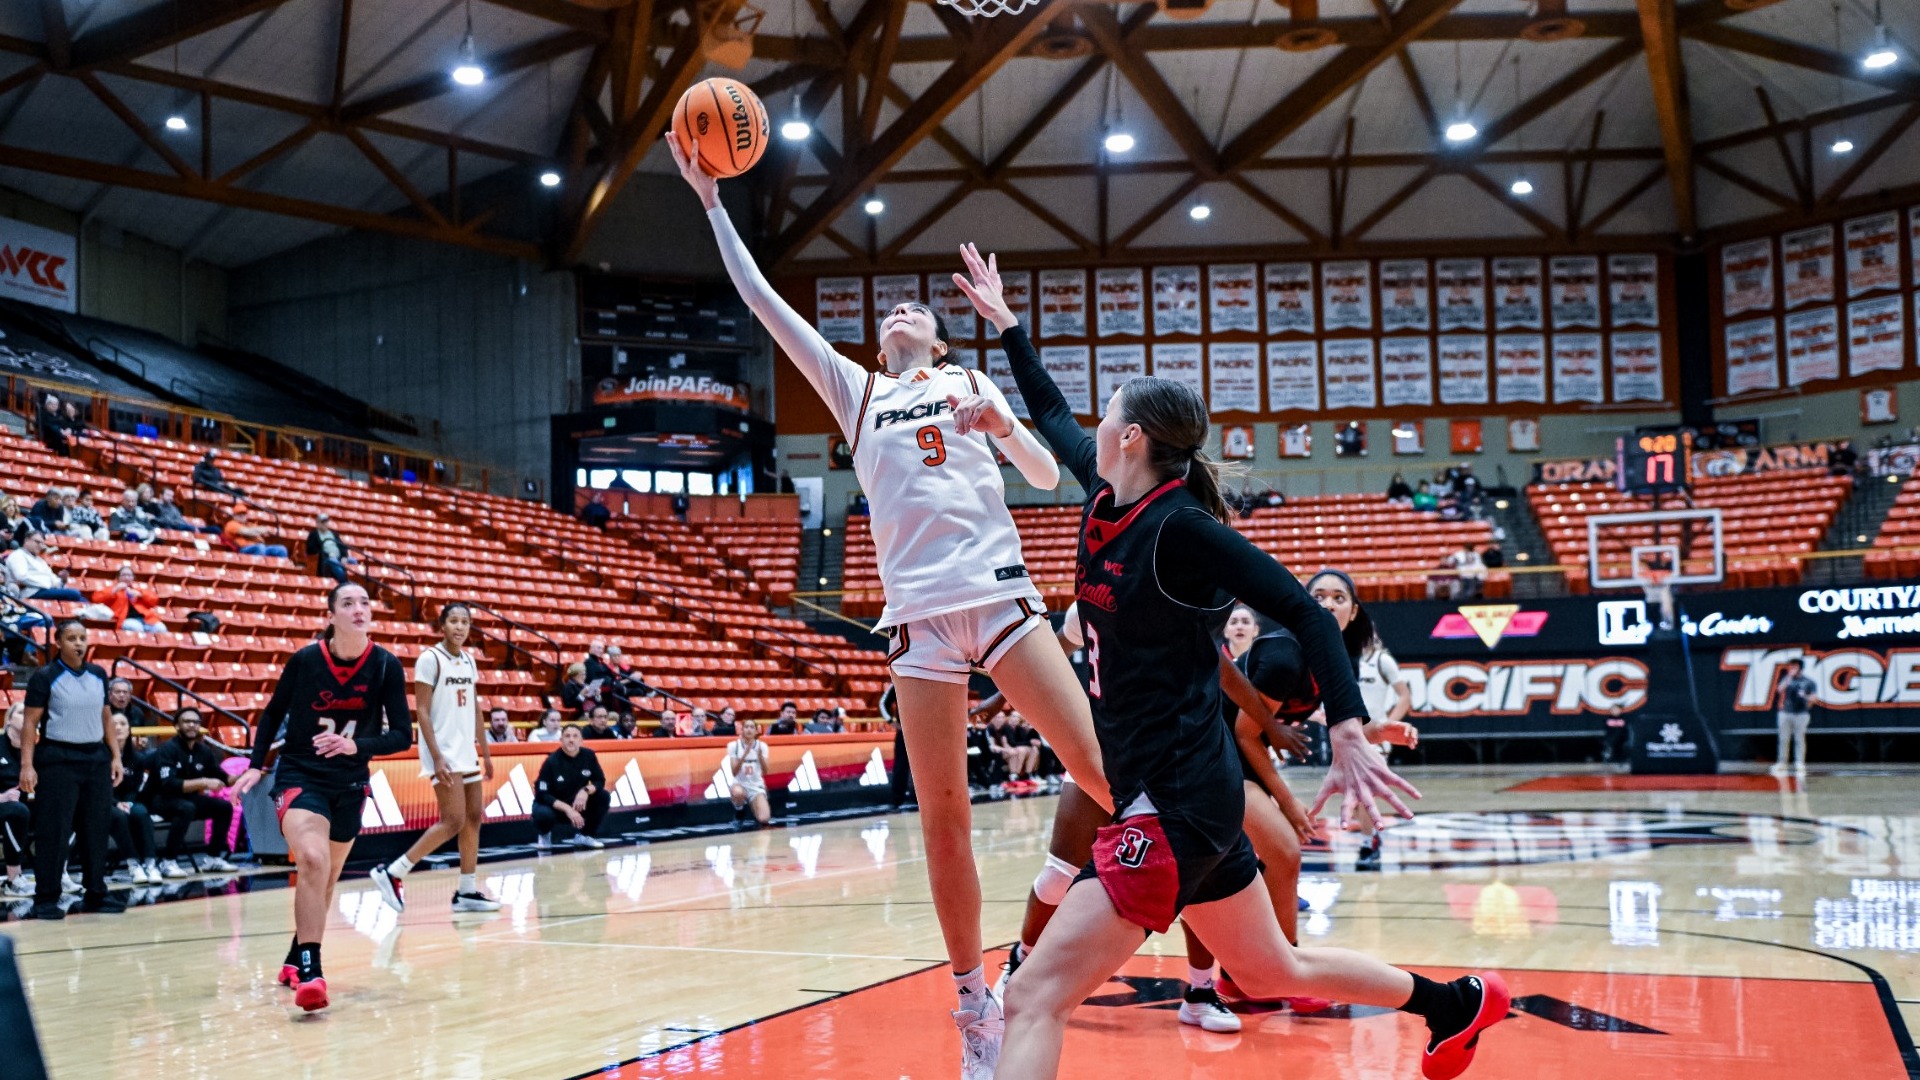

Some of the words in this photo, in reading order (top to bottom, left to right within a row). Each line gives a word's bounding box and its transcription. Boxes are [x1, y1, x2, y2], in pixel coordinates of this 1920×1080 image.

[725, 85, 752, 152] Wilson
[624, 374, 734, 401] JoinPAF.org
[874, 401, 955, 432] PACIF
[916, 424, 947, 467] 9
[1753, 442, 1829, 471] ARM
[1647, 453, 1674, 484] 17
[457, 688, 466, 708] 15
[1392, 656, 1650, 717] ACIFIC
